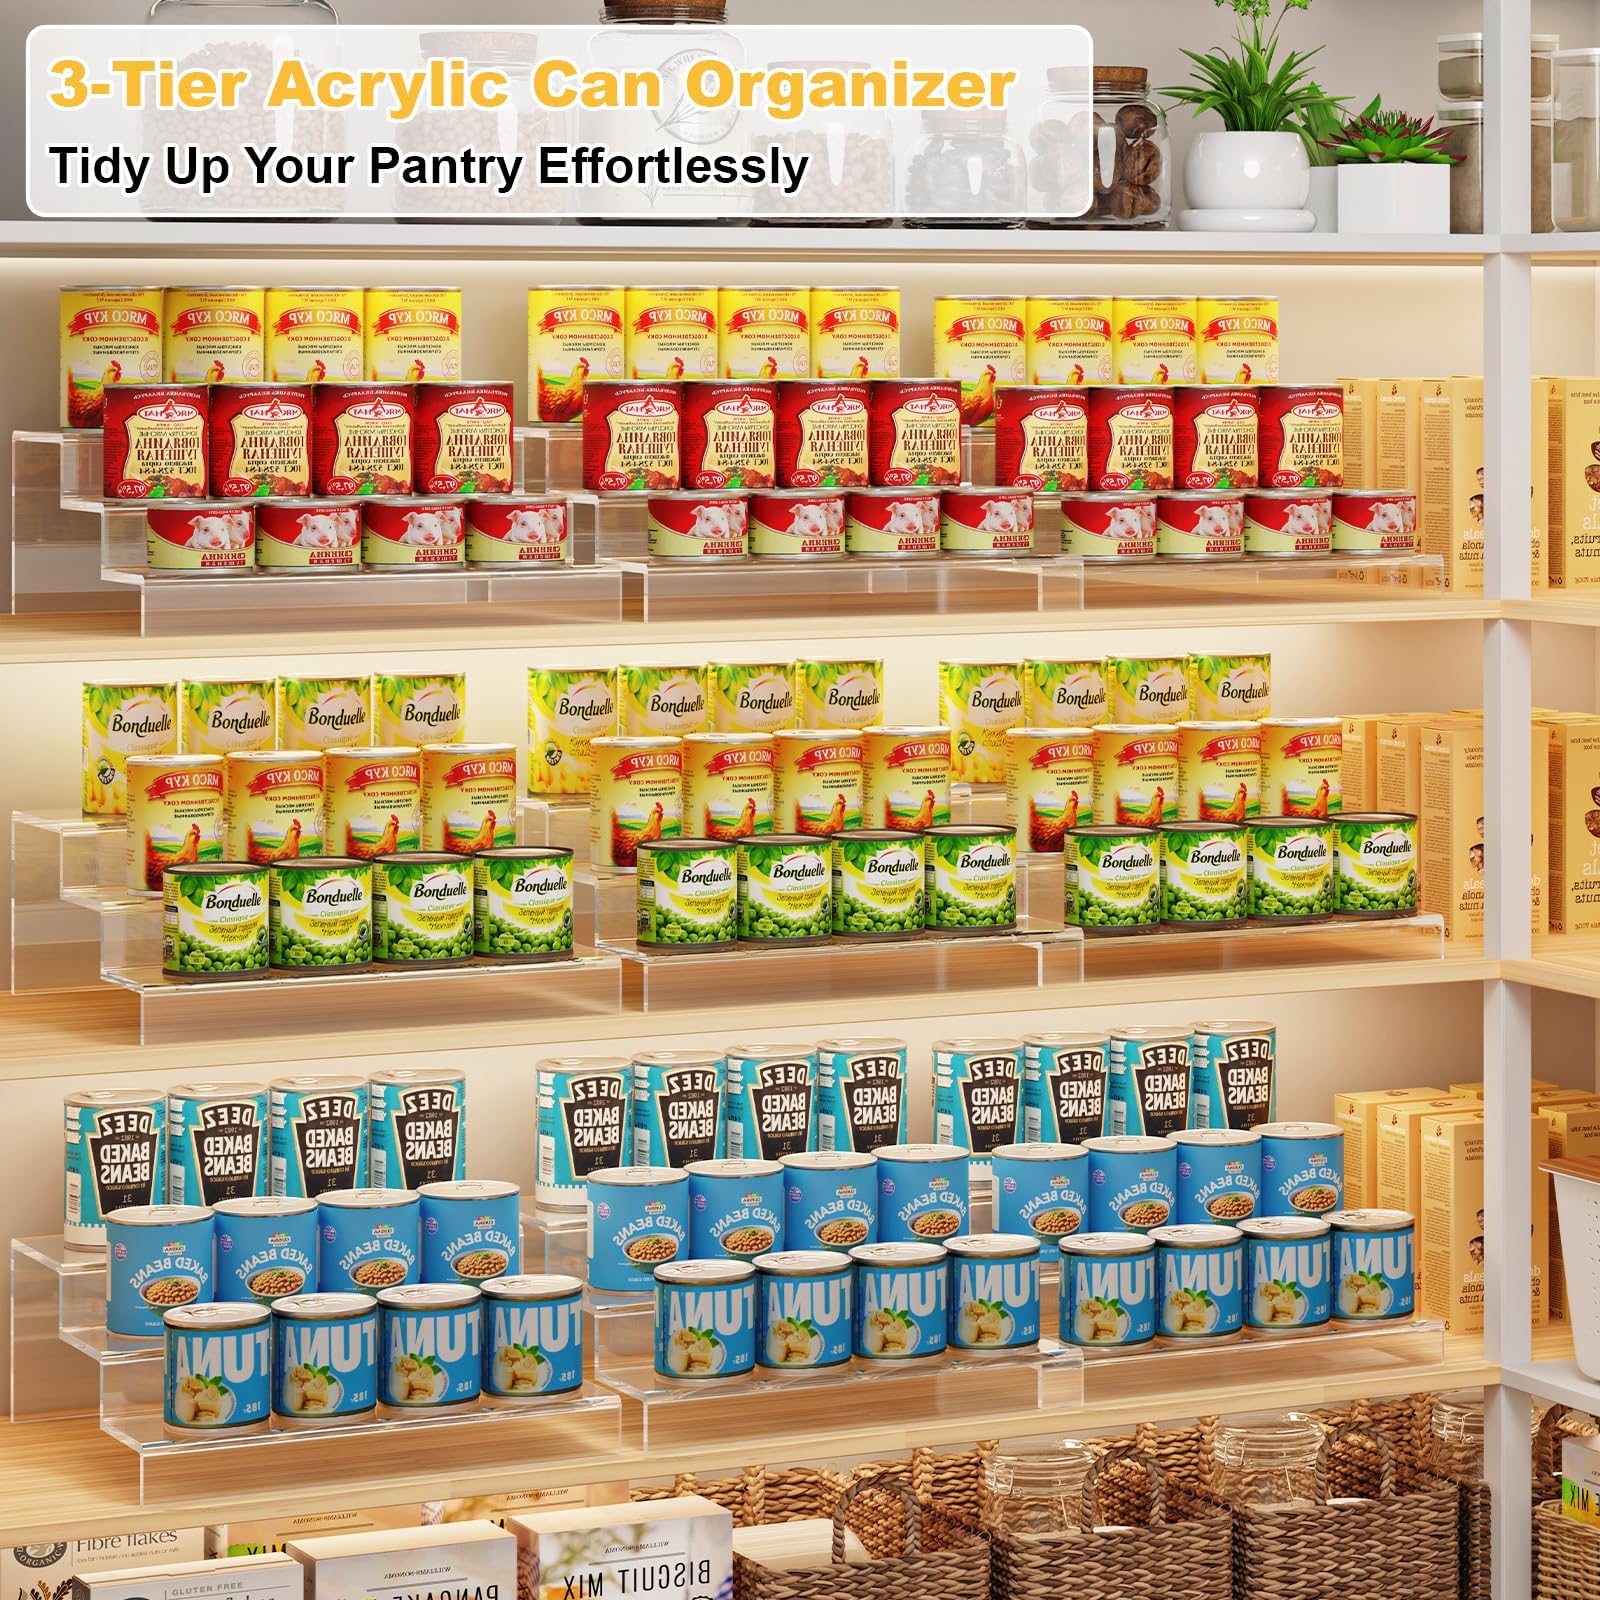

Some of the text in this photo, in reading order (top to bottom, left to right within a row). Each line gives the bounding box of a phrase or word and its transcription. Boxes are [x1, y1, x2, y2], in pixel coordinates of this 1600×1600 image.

[829, 688, 879, 710] Bonduelle
[972, 691, 1021, 712] Bonduelle
[1057, 688, 1105, 709] Bonduelle
[1140, 685, 1187, 706] Bonduelle
[1222, 682, 1268, 703] Bonduelle
[560, 698, 613, 720] Bonduelle
[651, 695, 703, 717] Bonduelle
[740, 692, 791, 714] Bonduelle
[112, 707, 171, 738] Bonduelle
[212, 704, 270, 734] Bonduelle
[309, 707, 365, 730] Bonduelle
[405, 704, 459, 726] Bonduelle
[1191, 849, 1240, 866] Bonduelle
[1278, 844, 1326, 861] Bonduelle
[1364, 840, 1411, 856] Bonduelle
[868, 858, 918, 876] Bonduelle
[961, 853, 1010, 871] Bonduelle
[1102, 854, 1152, 871] Bonduelle
[682, 864, 732, 886] Bonduelle
[774, 863, 825, 881] Bonduelle
[414, 882, 466, 900] Bonduelle
[515, 876, 567, 895] Bonduelle
[206, 892, 261, 912] Bonduelle
[306, 888, 362, 906] Bonduelle
[320, 910, 349, 918] Classique
[427, 903, 455, 912] Classique
[220, 914, 248, 923] Classique
[20, 1550, 61, 1567] ORGANIC
[172, 1581, 244, 1596] GLUTEN FREE
